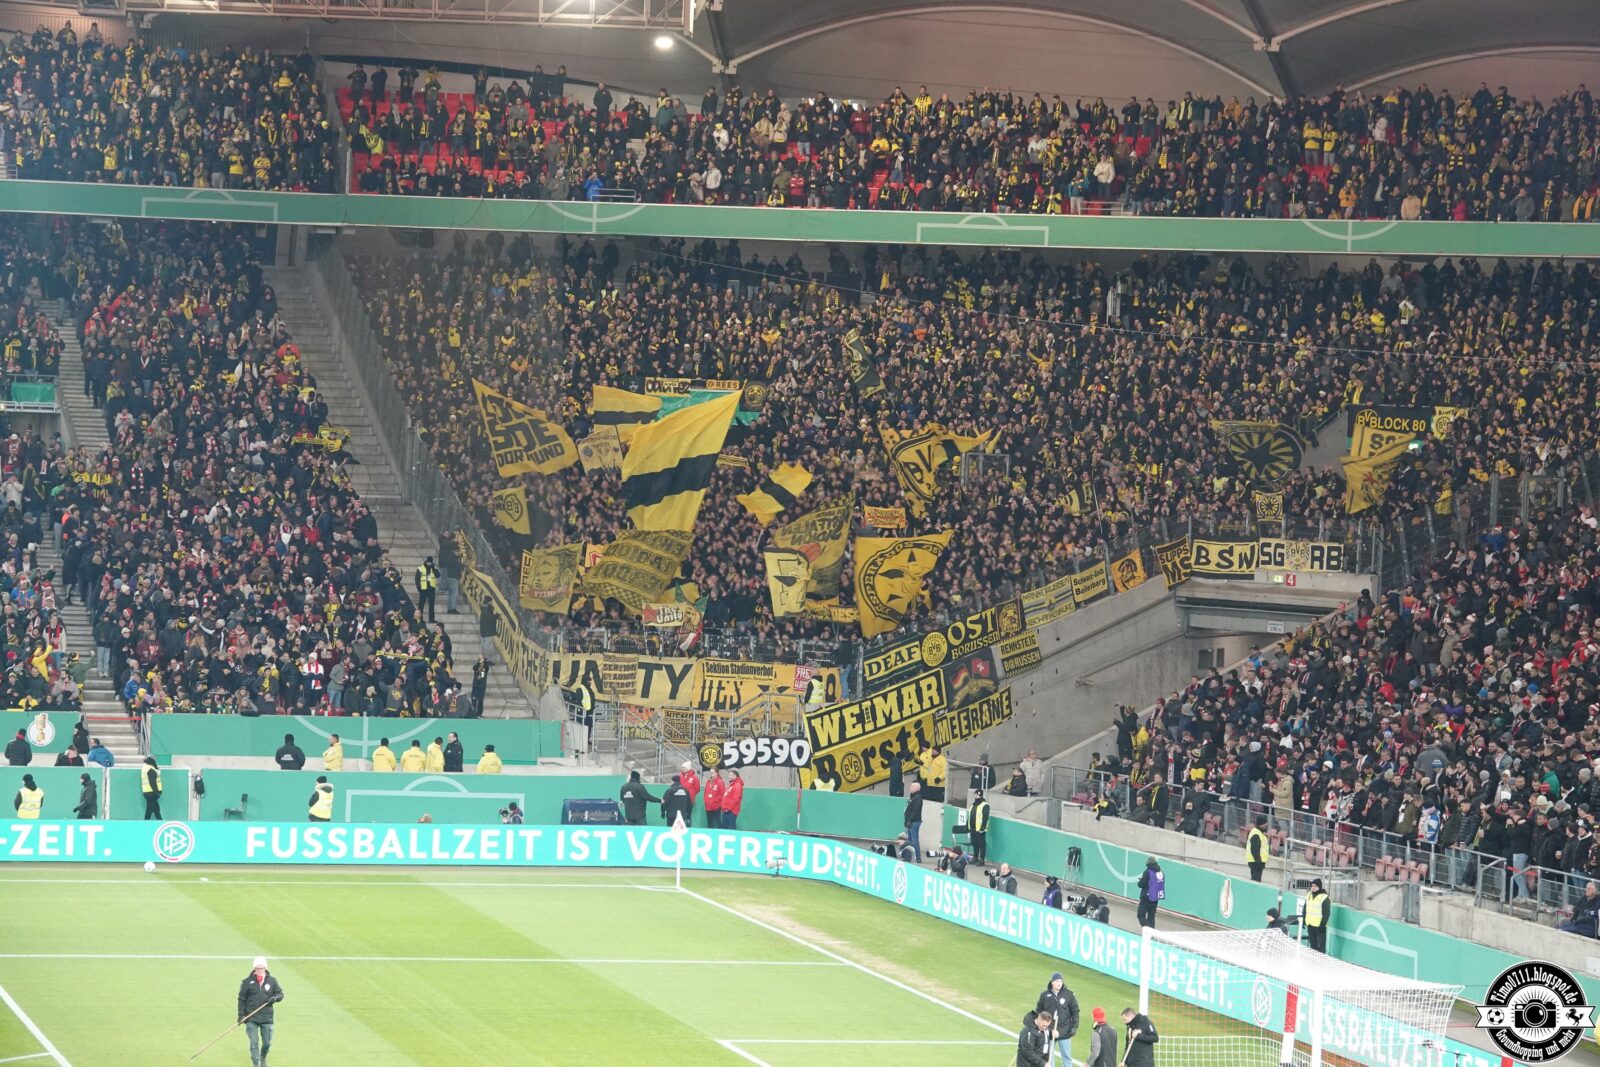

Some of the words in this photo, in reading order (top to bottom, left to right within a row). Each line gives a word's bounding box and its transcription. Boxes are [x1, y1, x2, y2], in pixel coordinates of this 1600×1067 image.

[716, 381, 738, 389] REES
[1412, 419, 1427, 432] 80
[1260, 542, 1285, 566] SG
[1310, 545, 1343, 570] RB
[1287, 574, 1295, 585] 4
[947, 608, 997, 646] OST
[1000, 634, 1037, 655] RENNSTEIG
[705, 661, 730, 674] Sektion
[867, 643, 920, 677] DEAF
[811, 675, 945, 748] WEIMAR
[936, 689, 1013, 747] MEERANE
[723, 737, 811, 767] 59590
[246, 826, 541, 860] FUSSBALLZEIT
[555, 829, 616, 861] IST
[923, 875, 1034, 941] FUSSBALLZEIT
[1038, 911, 1066, 946] IST
